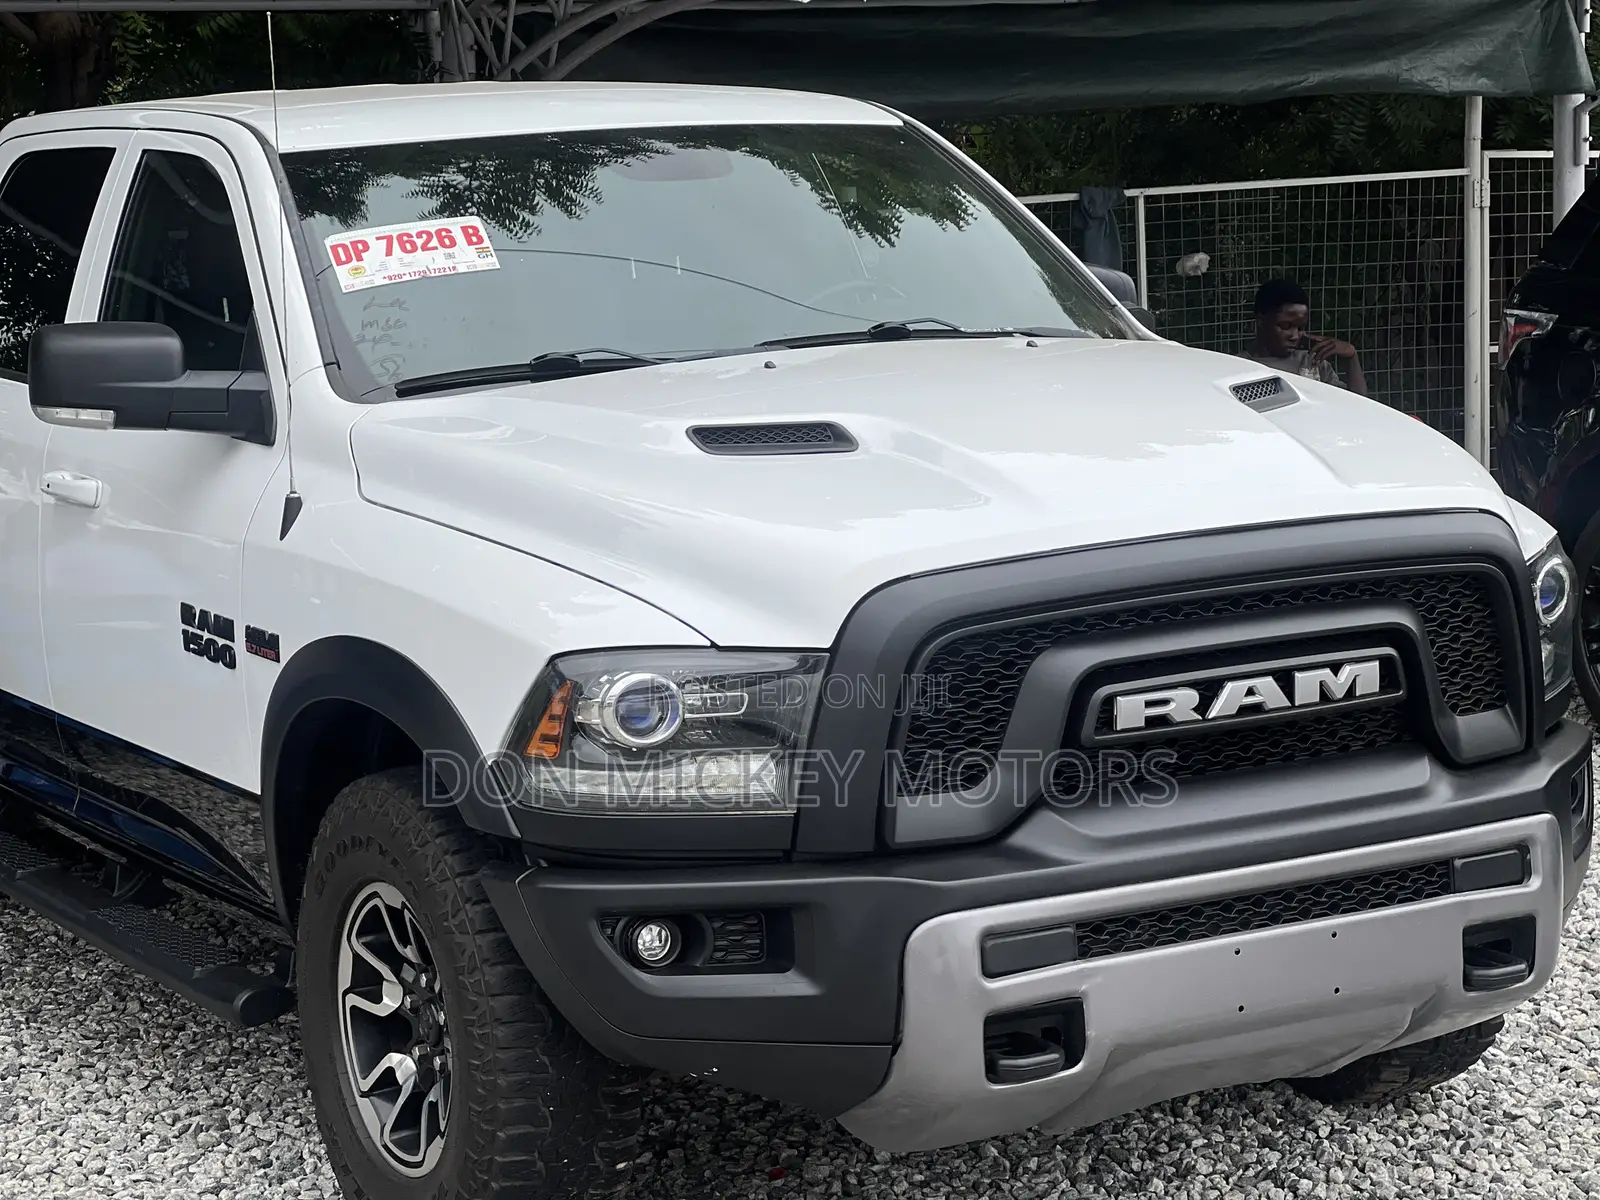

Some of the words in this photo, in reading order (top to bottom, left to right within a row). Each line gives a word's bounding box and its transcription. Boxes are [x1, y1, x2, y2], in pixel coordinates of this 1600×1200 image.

[330, 239, 370, 266] DP
[375, 227, 457, 257] 7626
[460, 225, 484, 246] B
[477, 252, 494, 260] GH
[180, 601, 235, 643] RAM
[181, 628, 237, 670] 1500
[256, 645, 277, 661] LITER
[1112, 659, 1380, 732] RAM
